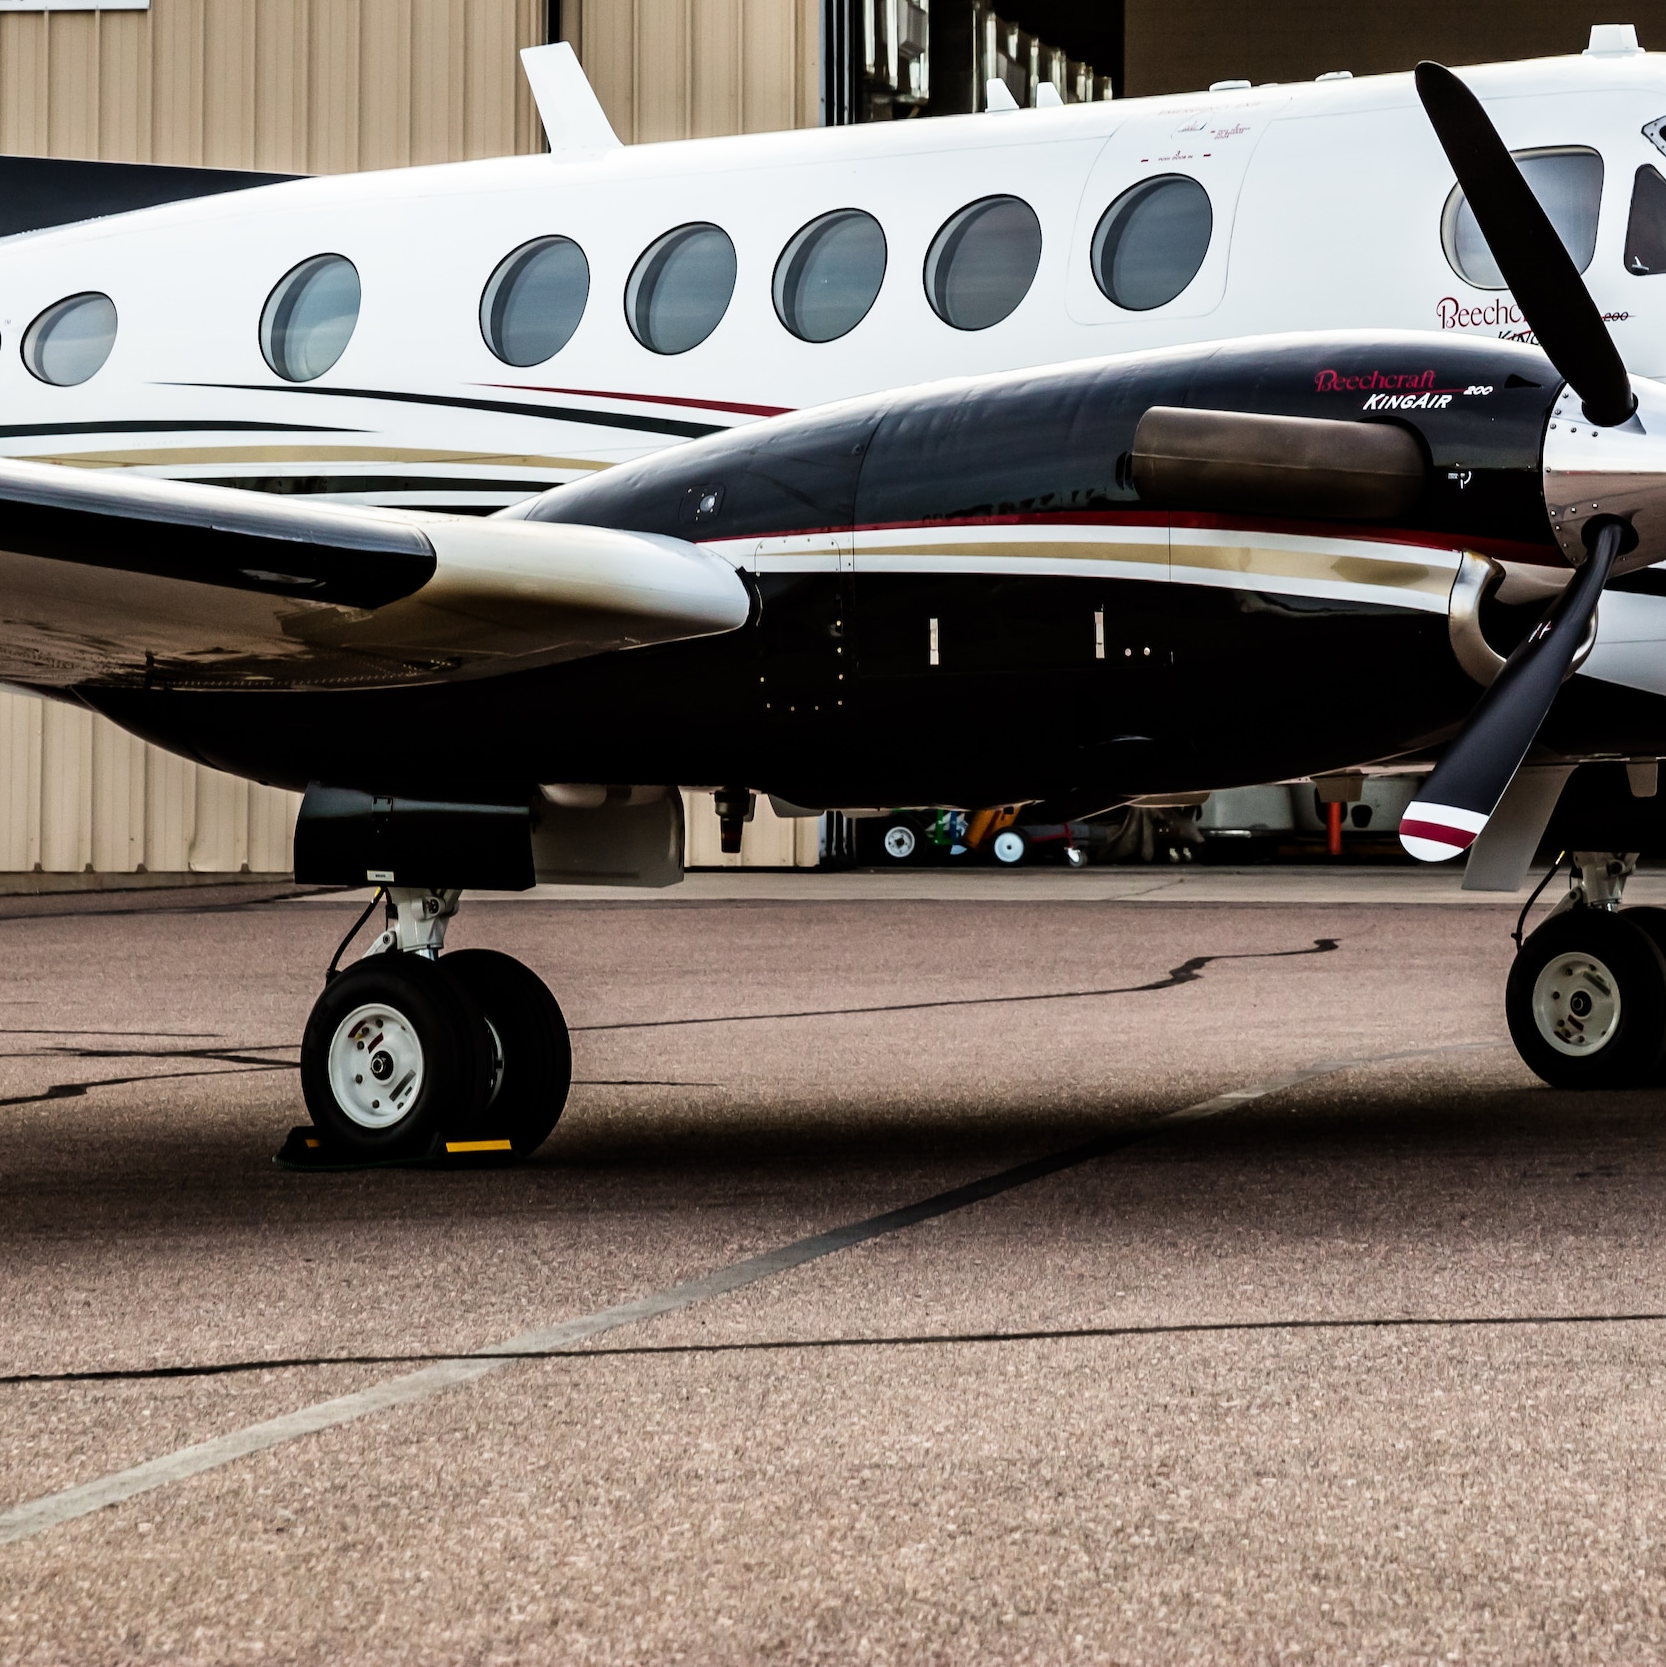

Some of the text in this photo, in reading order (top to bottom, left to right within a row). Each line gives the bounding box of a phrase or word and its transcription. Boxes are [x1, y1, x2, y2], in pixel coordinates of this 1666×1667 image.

[1436, 296, 1528, 330] Beechc
[1604, 310, 1629, 323] 200
[1314, 368, 1437, 393] Beechcraft
[1463, 384, 1494, 397] 200
